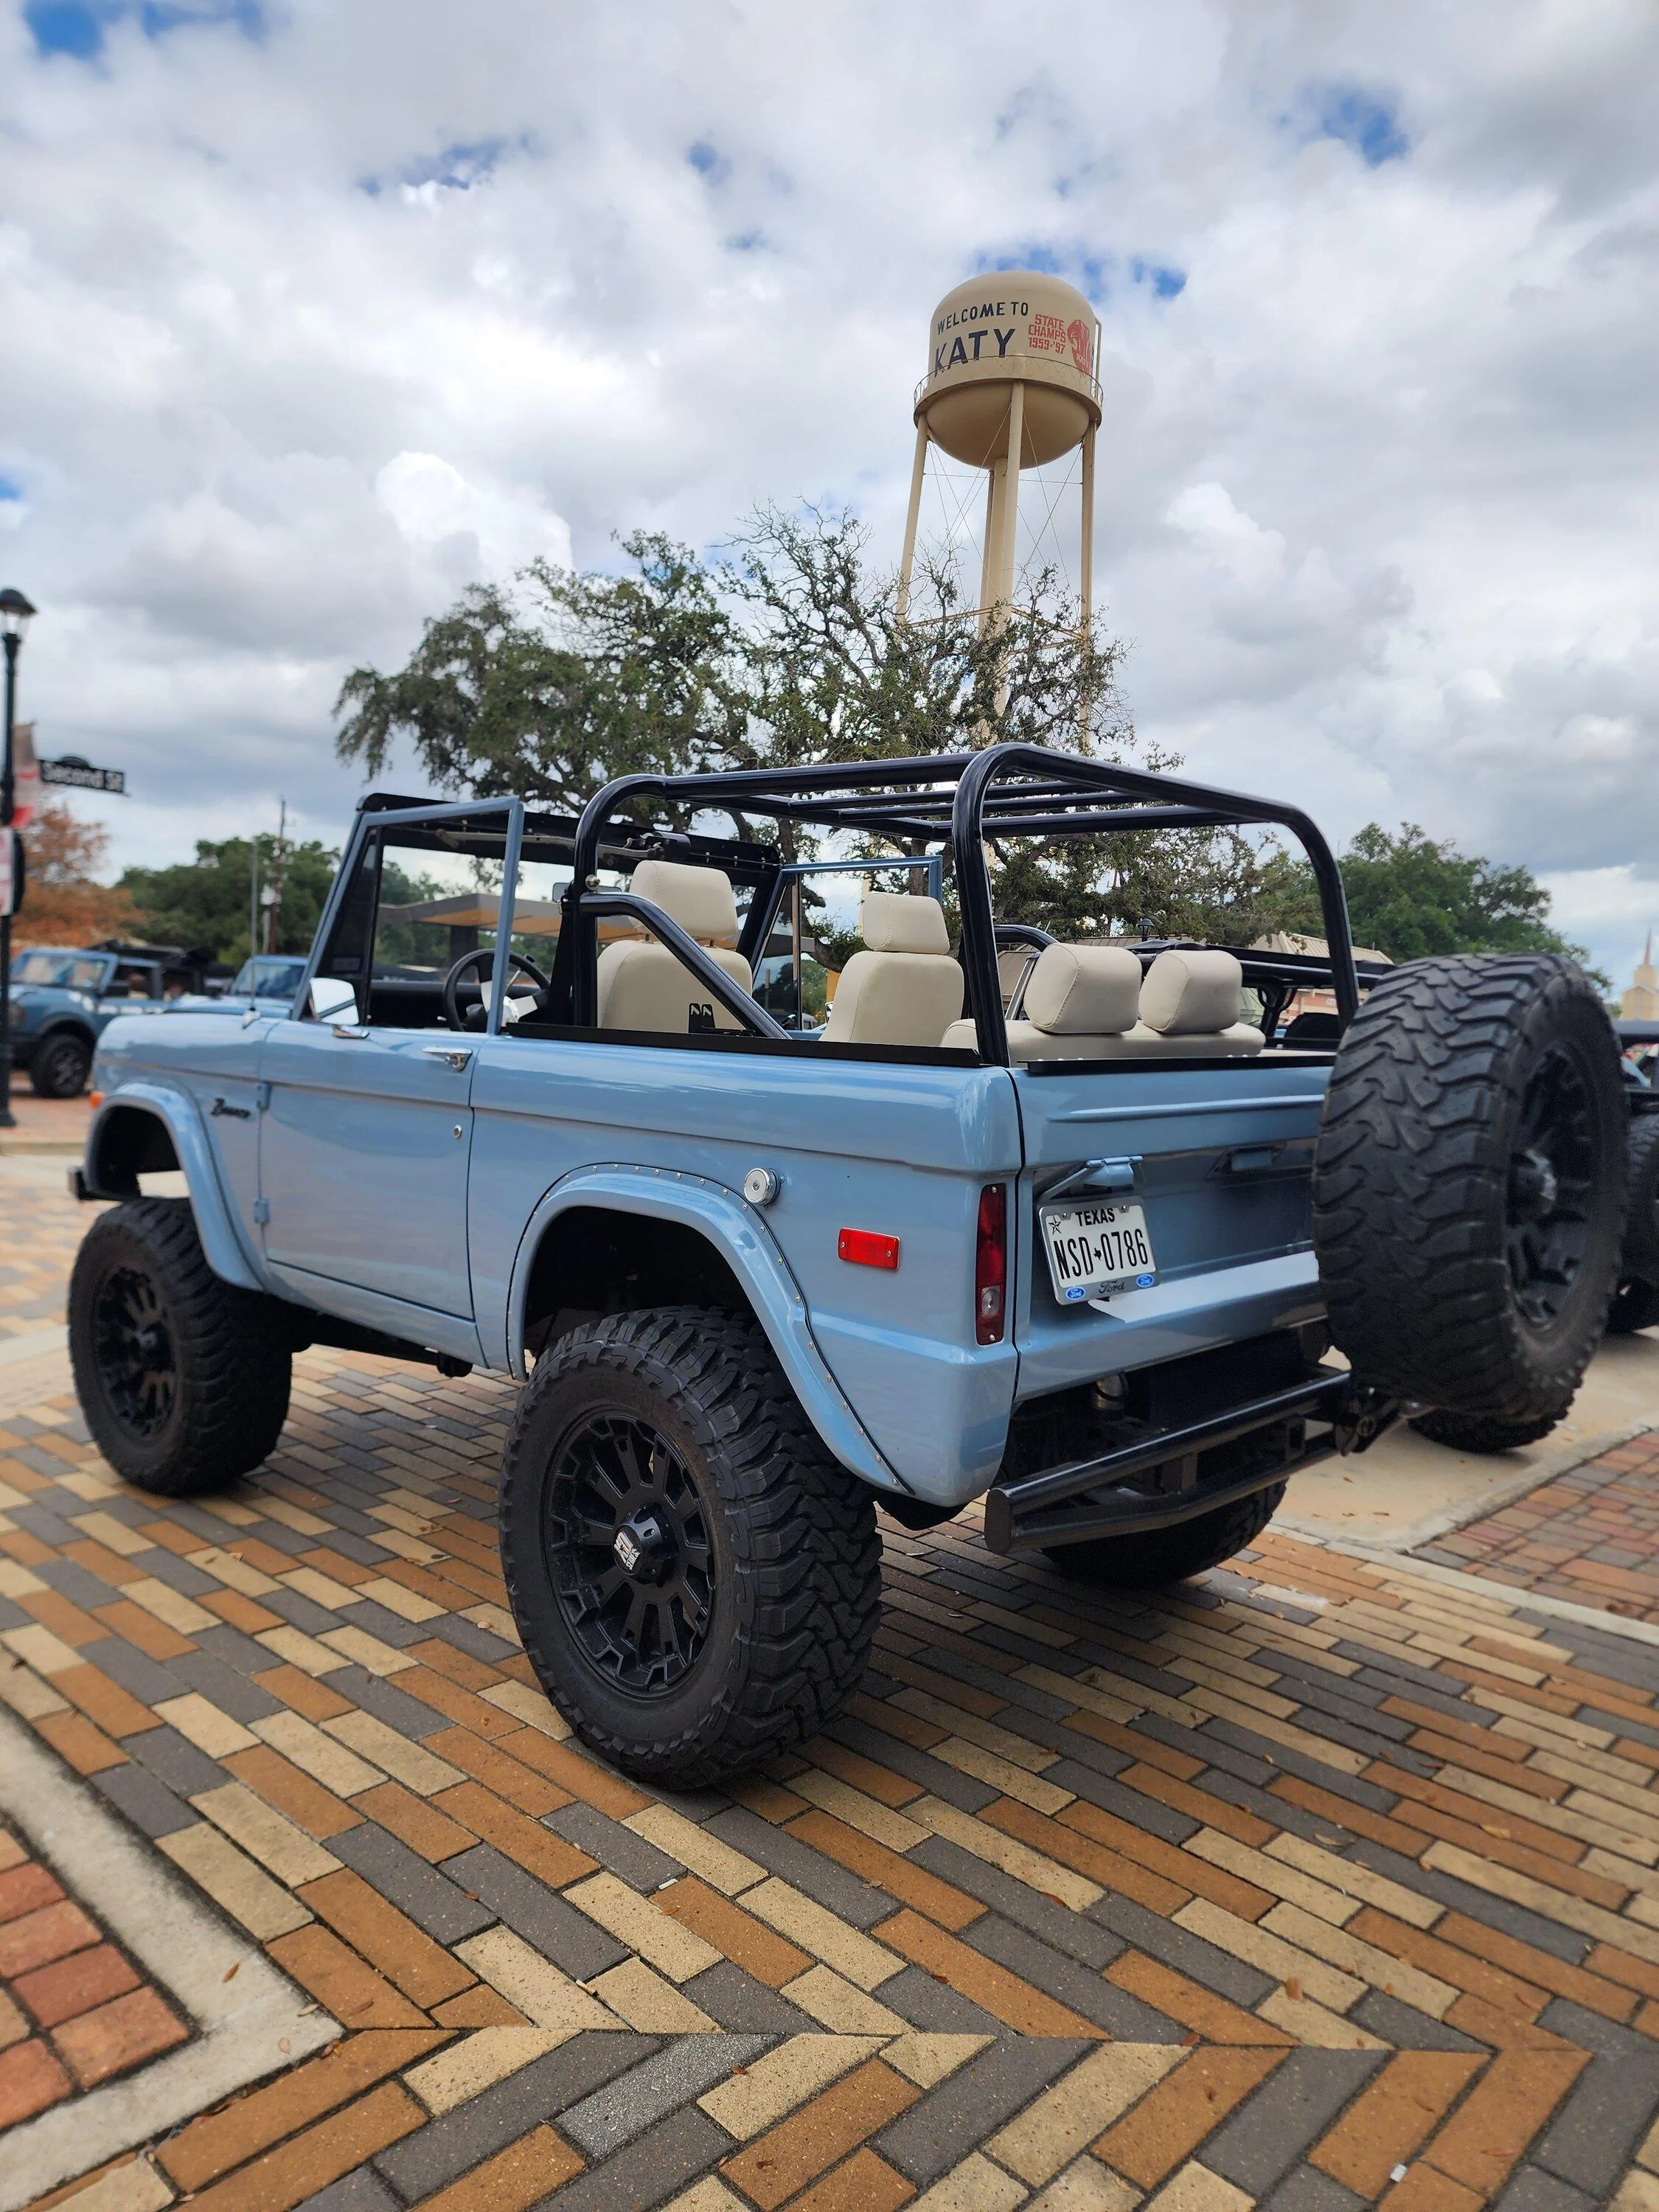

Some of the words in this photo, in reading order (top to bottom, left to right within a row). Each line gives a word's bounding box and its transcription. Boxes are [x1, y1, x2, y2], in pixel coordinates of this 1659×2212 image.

[937, 302, 1006, 335] WELCOME
[1010, 302, 1029, 316] TO
[1034, 314, 1064, 331] STATE
[1028, 324, 1066, 343] CHAMPS
[933, 329, 1016, 378] KATY
[42, 762, 103, 787] Second
[105, 772, 122, 790] St
[1075, 1208, 1116, 1226] TEXAS
[1099, 1280, 1124, 1293] Ford
[626, 1548, 640, 1571] SERIES
